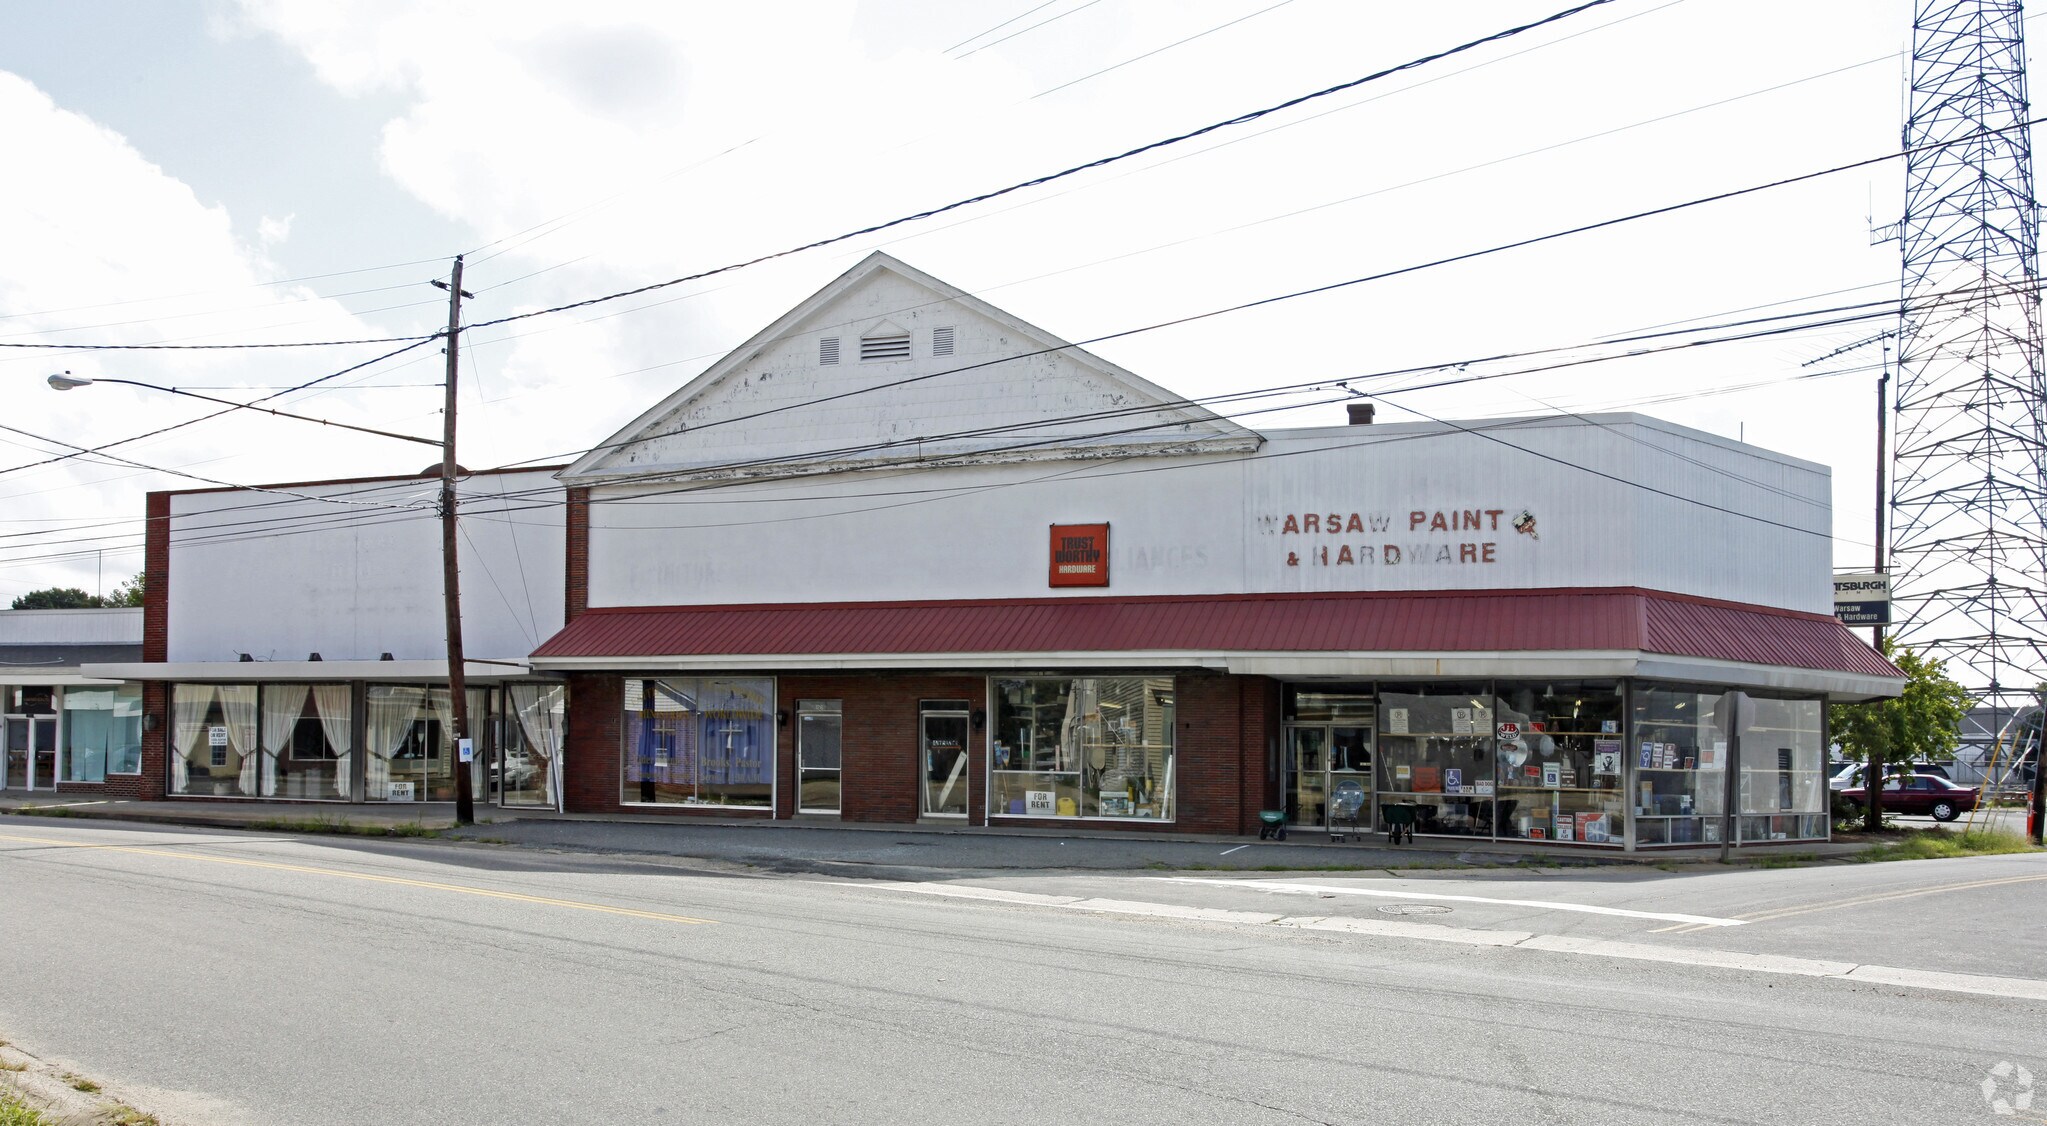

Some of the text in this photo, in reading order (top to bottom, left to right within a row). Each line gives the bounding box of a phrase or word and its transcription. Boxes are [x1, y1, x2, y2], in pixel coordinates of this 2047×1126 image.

[1257, 509, 1504, 535] WARSAW PAINT
[1061, 536, 1095, 549] TRUST
[1055, 549, 1100, 563] WORTHY
[1286, 542, 1498, 566] & HARDWARE
[1058, 564, 1097, 574] HARDWARE
[1834, 604, 1861, 612] Warsaw
[1844, 613, 1878, 621] Hardware
[705, 709, 764, 720] WORLDWIDE
[736, 757, 761, 768] Pastor
[1033, 792, 1048, 801] FOR
[1031, 800, 1050, 809] RENT
